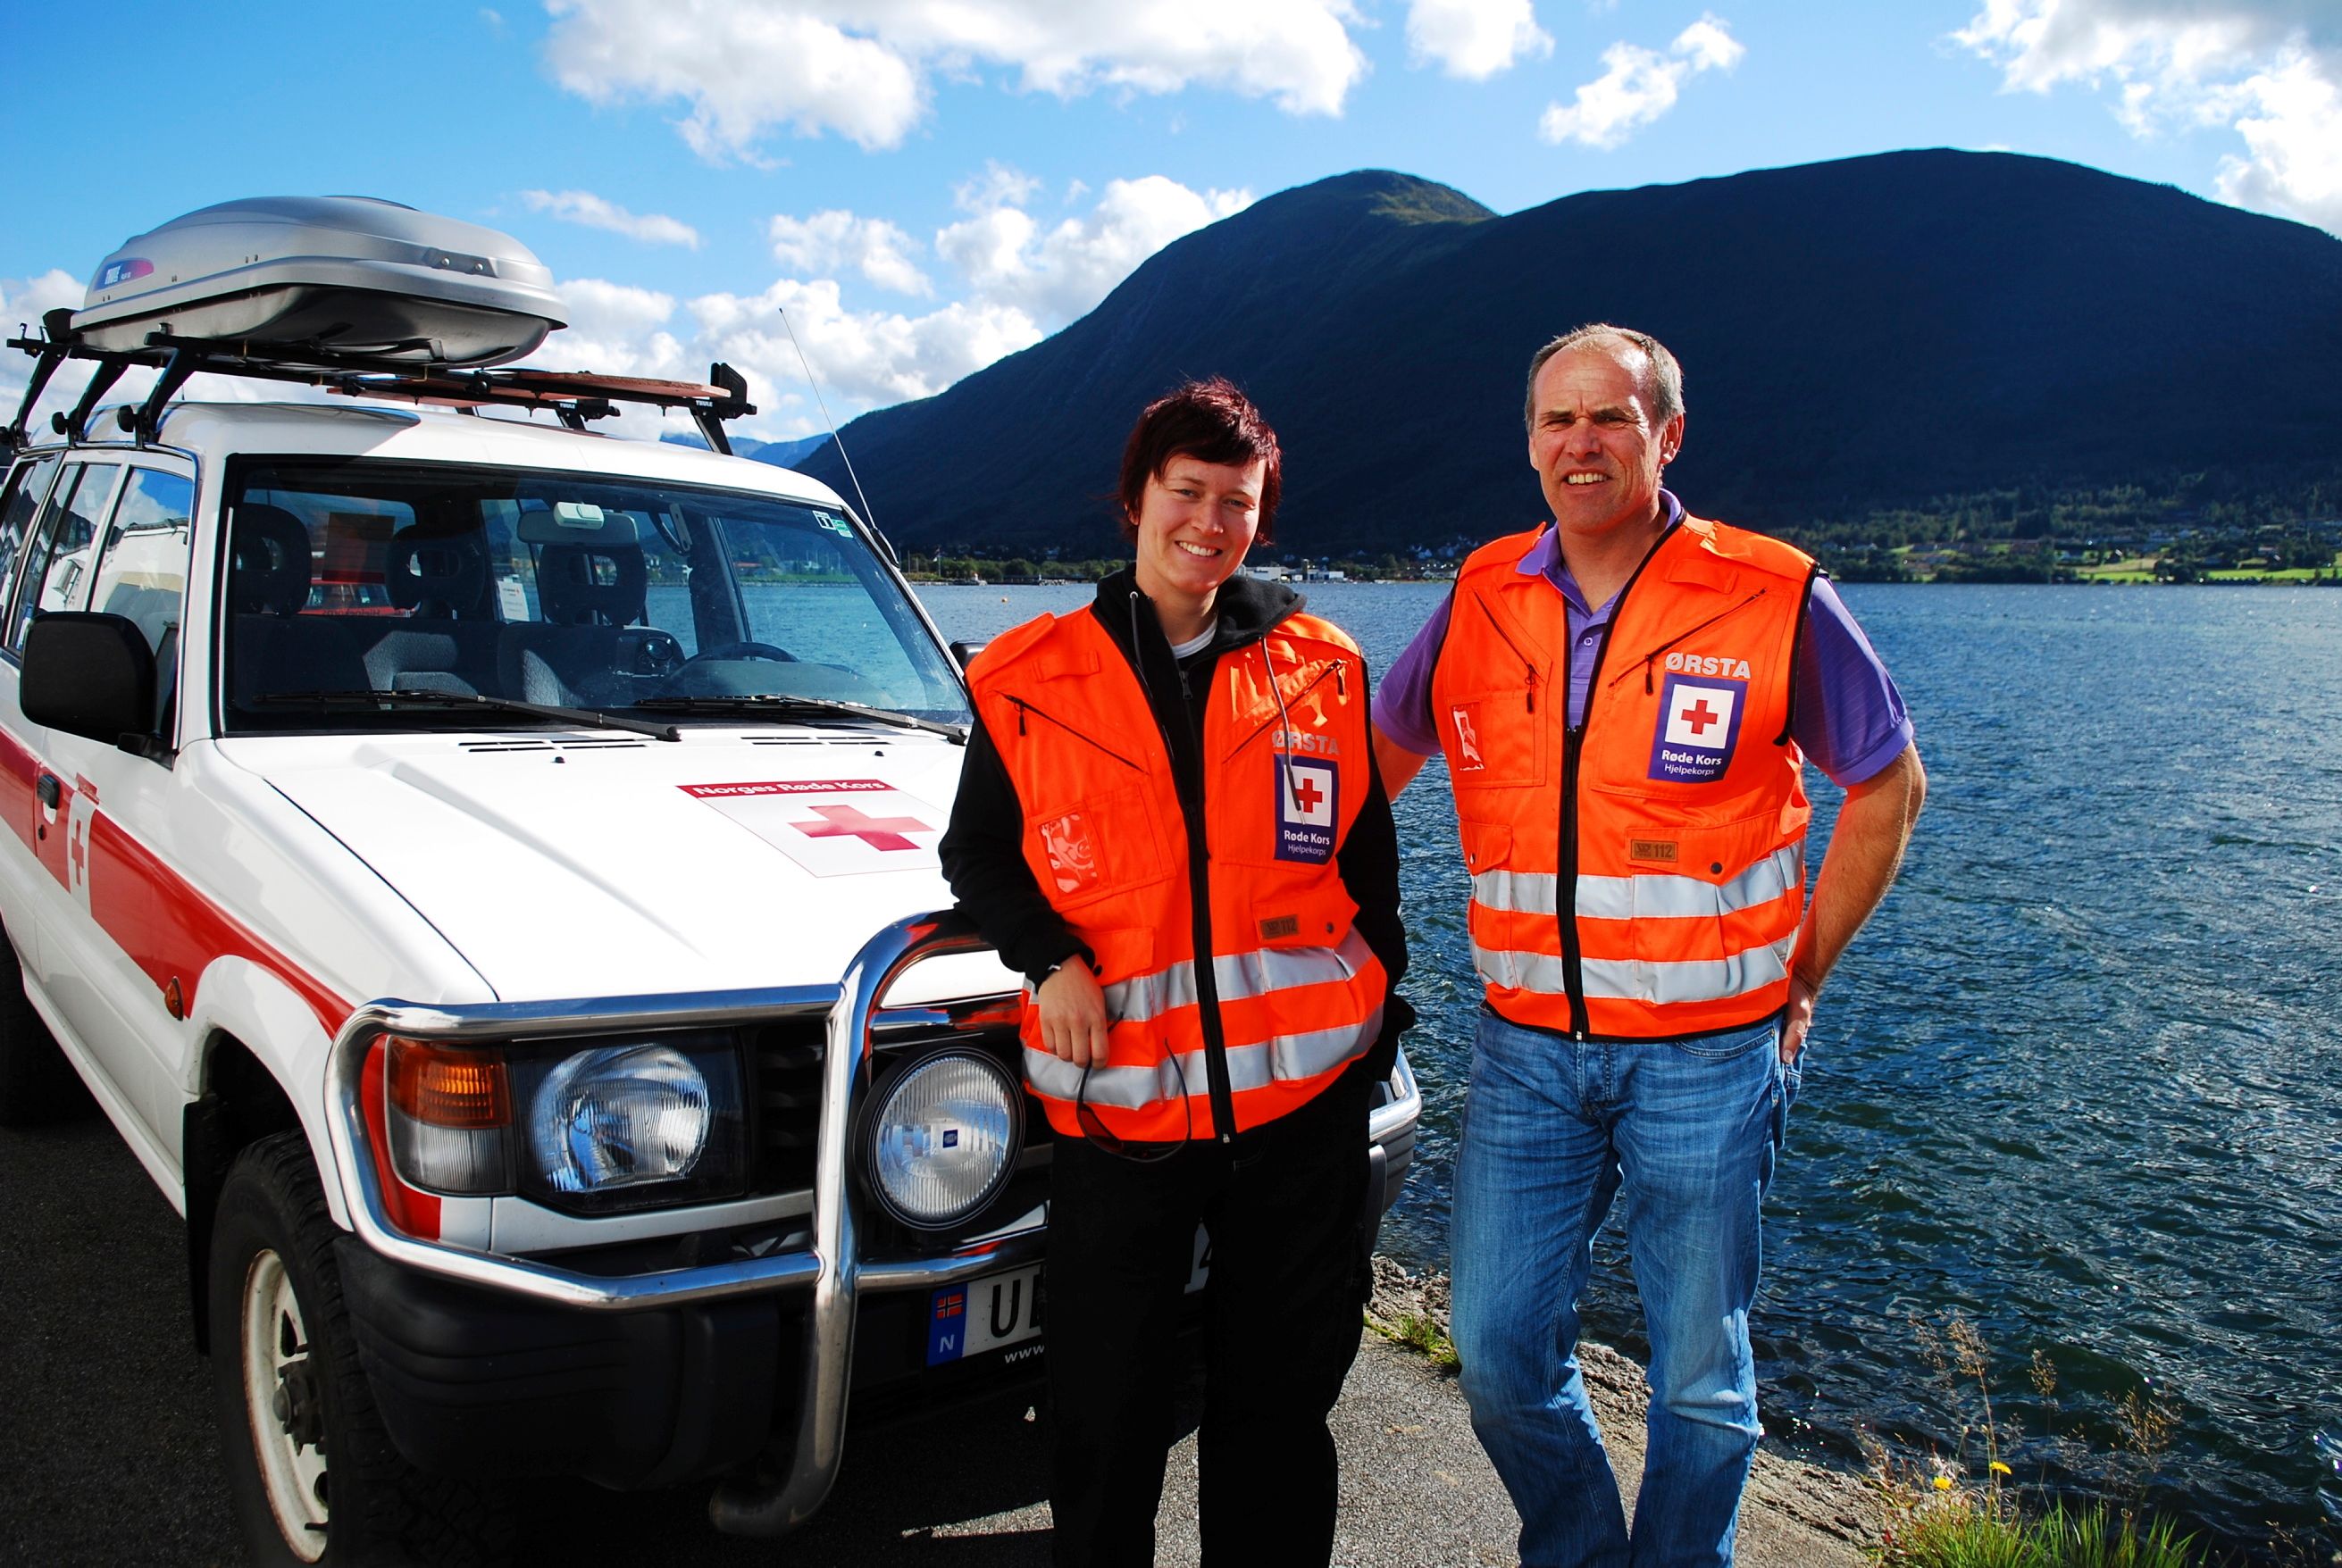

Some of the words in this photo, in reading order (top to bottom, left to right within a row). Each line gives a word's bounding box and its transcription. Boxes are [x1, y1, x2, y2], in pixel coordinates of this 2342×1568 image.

[1665, 652, 1751, 680] ØRSTA
[1272, 730, 1339, 755] ØRSTA
[1661, 750, 1694, 764] Røde
[1695, 754, 1722, 766] Kors
[1664, 763, 1715, 777] Hjelpekorps
[692, 783, 777, 796] Norges
[777, 782, 836, 793] Røde
[837, 781, 885, 790] Kors
[1284, 830, 1309, 842] Røde
[1310, 832, 1331, 846] Kors
[1287, 844, 1326, 857] Hjelpekorps
[1653, 844, 1673, 858] 112
[939, 1334, 955, 1354] N
